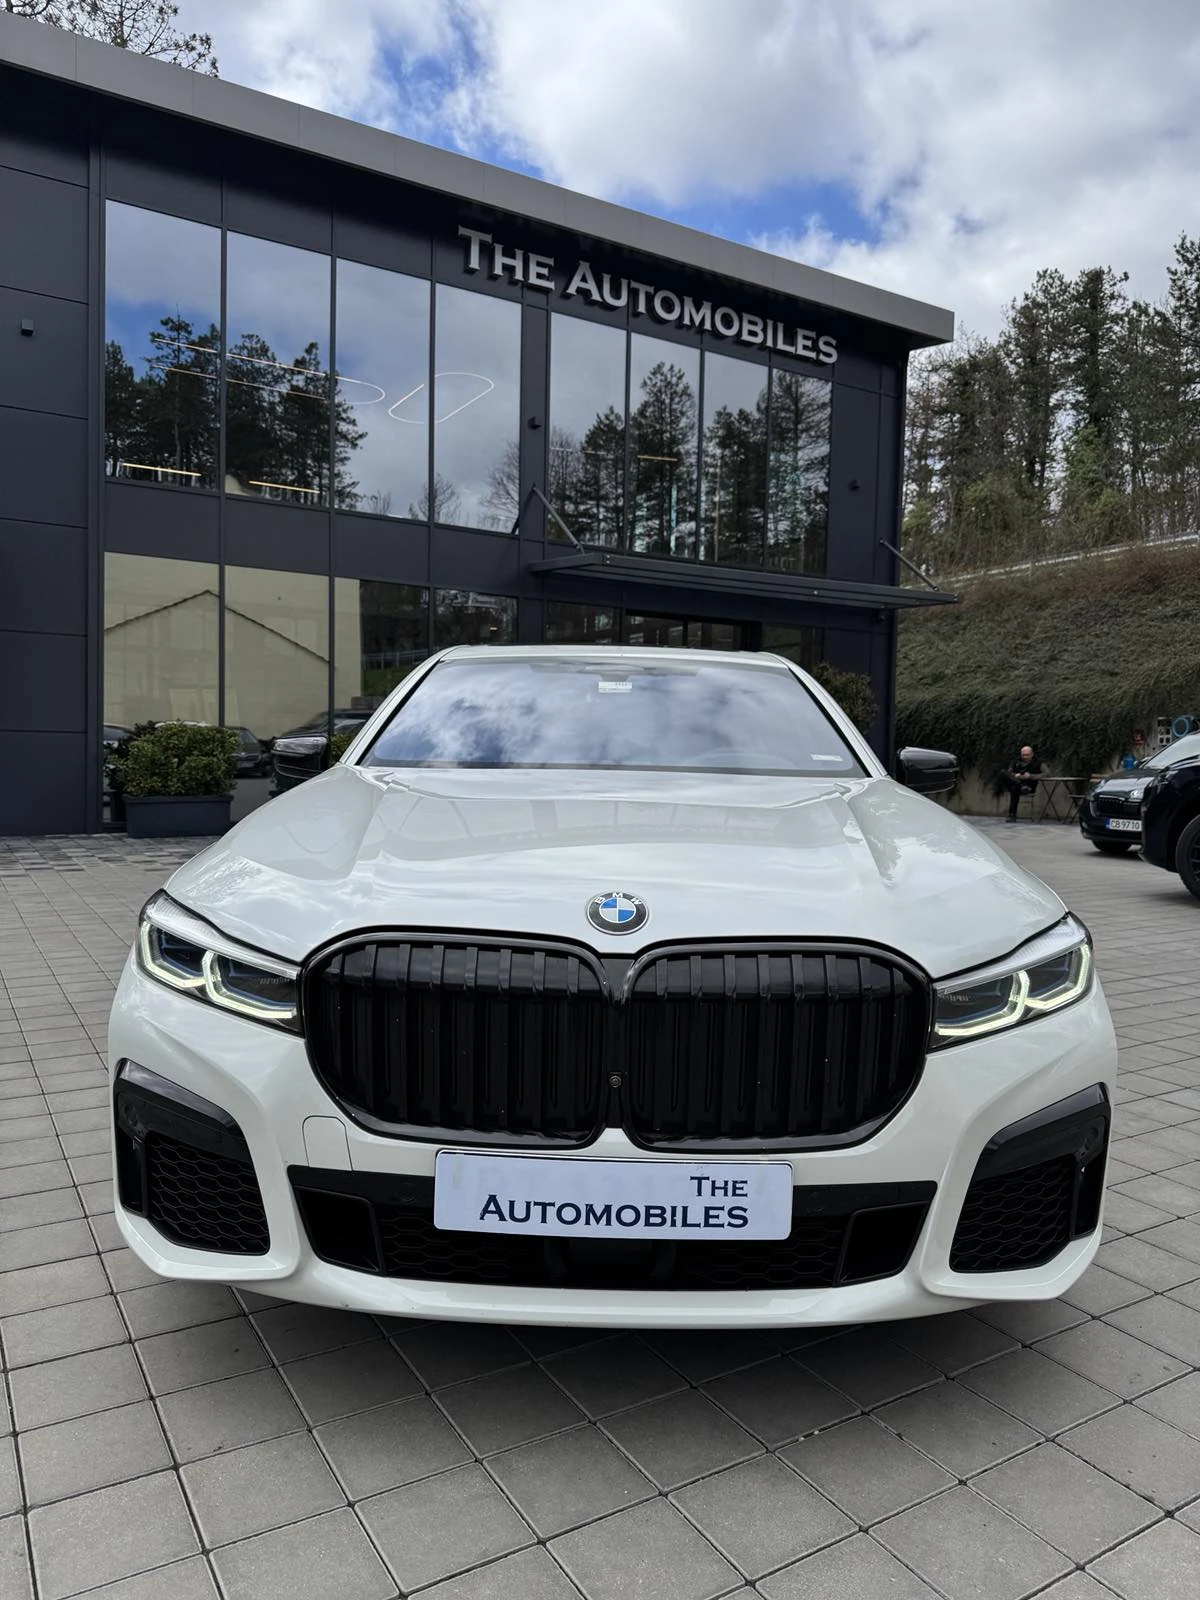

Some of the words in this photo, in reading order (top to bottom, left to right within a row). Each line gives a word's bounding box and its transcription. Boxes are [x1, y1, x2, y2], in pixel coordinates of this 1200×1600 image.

[458, 225, 555, 290] THE
[566, 260, 838, 364] AUTOMOBILES
[594, 892, 642, 905] BMW
[690, 1176, 749, 1197] THE
[479, 1194, 750, 1229] AUTOMOBILES
